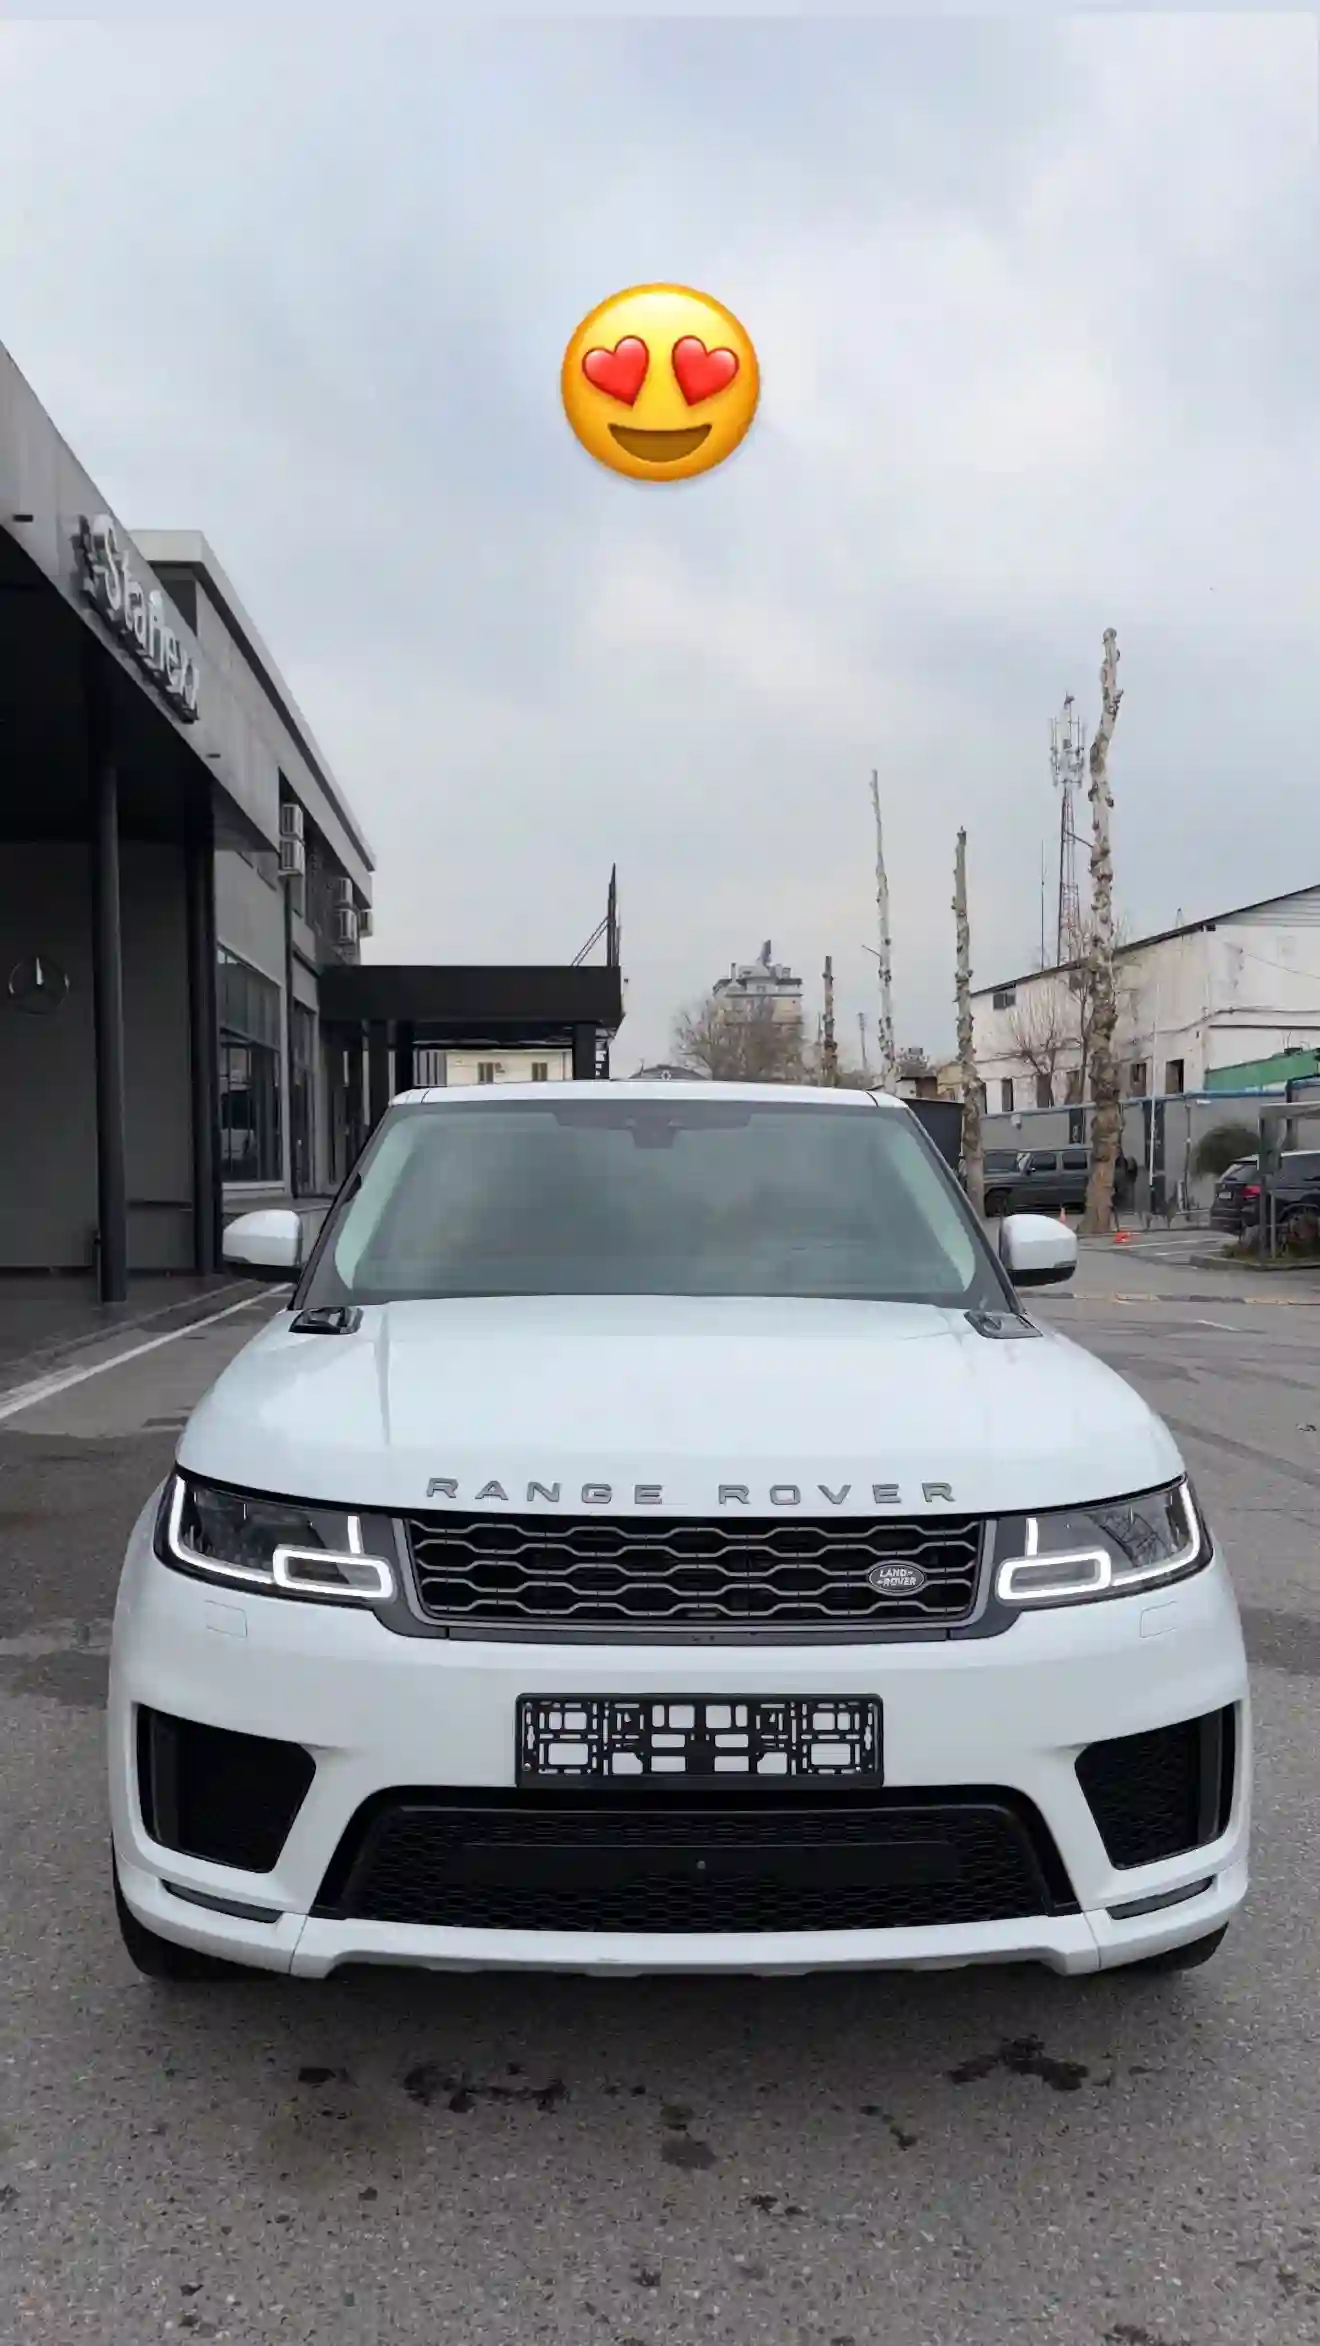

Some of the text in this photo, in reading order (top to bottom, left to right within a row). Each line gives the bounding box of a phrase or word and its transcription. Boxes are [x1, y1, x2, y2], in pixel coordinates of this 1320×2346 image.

[426, 1477, 956, 1505] RANGE ROVER
[882, 1576, 917, 1587] ROVER
